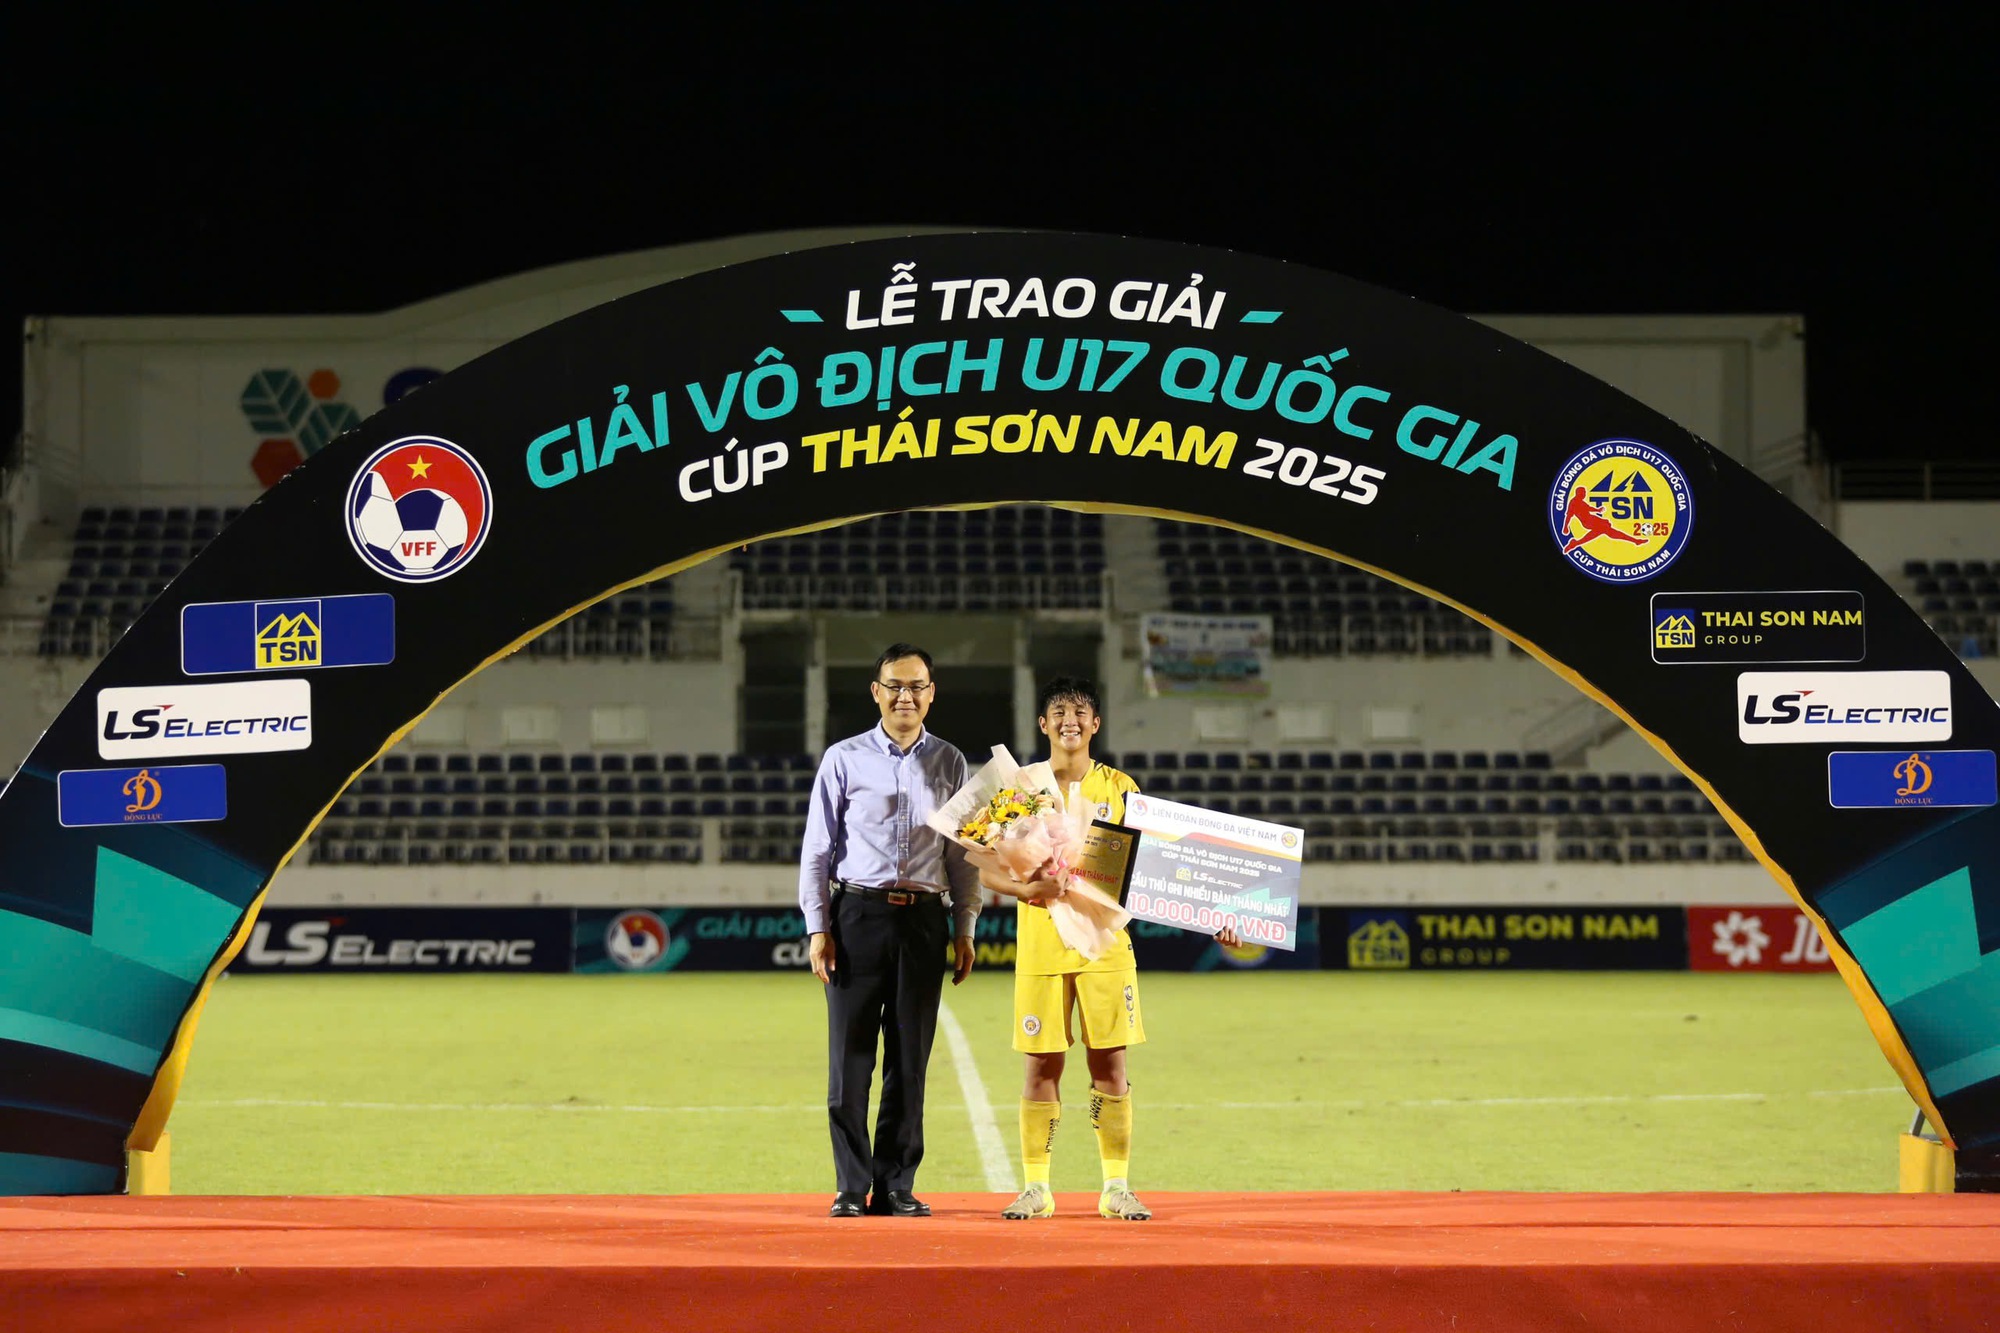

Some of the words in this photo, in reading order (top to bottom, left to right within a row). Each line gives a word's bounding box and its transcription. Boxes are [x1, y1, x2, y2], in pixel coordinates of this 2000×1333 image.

[846, 261, 917, 330] LỄ
[931, 277, 1096, 321] TRAO
[1109, 273, 1226, 330] GIẢI
[525, 384, 669, 489] GIẢI
[686, 346, 798, 432] VÔ
[816, 338, 1004, 411] ĐỊCH
[1021, 338, 1150, 392] U17
[1161, 347, 1391, 440] QUỐC
[1396, 404, 1518, 491] GIA
[678, 437, 788, 502] CÚP
[801, 405, 940, 473] THÁI
[951, 409, 1081, 456] SƠN
[1089, 415, 1238, 469] NAM
[1243, 438, 1386, 505] 2025
[1554, 489, 1566, 511] GIẢI
[1561, 463, 1582, 488] BÓNG
[1581, 450, 1597, 465] ĐÁ
[1598, 445, 1613, 456] VÔ
[1616, 445, 1641, 456] ĐỊCH
[1642, 450, 1662, 465] U17
[1661, 464, 1683, 491] QUỐC
[1676, 492, 1686, 511] GIA
[1589, 496, 1653, 519] TSN
[401, 541, 437, 557] VFF
[1573, 550, 1594, 567] CÚP
[1596, 563, 1620, 577] THÁI
[1623, 565, 1646, 577] SƠN
[1648, 549, 1671, 569] NAM
[1702, 611, 1753, 626] THAI
[1760, 611, 1806, 626] SON
[1812, 610, 1862, 626] NAM
[1658, 632, 1693, 645] TSN
[1704, 635, 1763, 644] GROUP
[260, 640, 317, 663] TSN
[1744, 694, 1801, 724] LS
[1804, 705, 1948, 724] ELECTRIC
[104, 709, 161, 740] LS
[163, 715, 308, 738] ELECTRIC
[1895, 797, 1916, 805] ĐỘNG
[124, 813, 145, 823] ĐỘNG
[1258, 831, 1277, 841] NAM
[1195, 847, 1207, 858] VÔ
[1230, 855, 1244, 865] U17
[1268, 864, 1282, 874] GIA
[1239, 866, 1260, 877] 2025
[1167, 882, 1183, 894] GHI
[1193, 872, 1208, 881] LS
[1129, 892, 1237, 932] 10.000.000
[1241, 914, 1286, 942] VNĐ
[1418, 915, 1495, 939] THAI
[1504, 914, 1573, 939] SON
[1583, 914, 1659, 939] NAM
[245, 921, 330, 965] LS
[329, 935, 535, 965] ELECTRIC
[1420, 948, 1510, 965] GROUP
